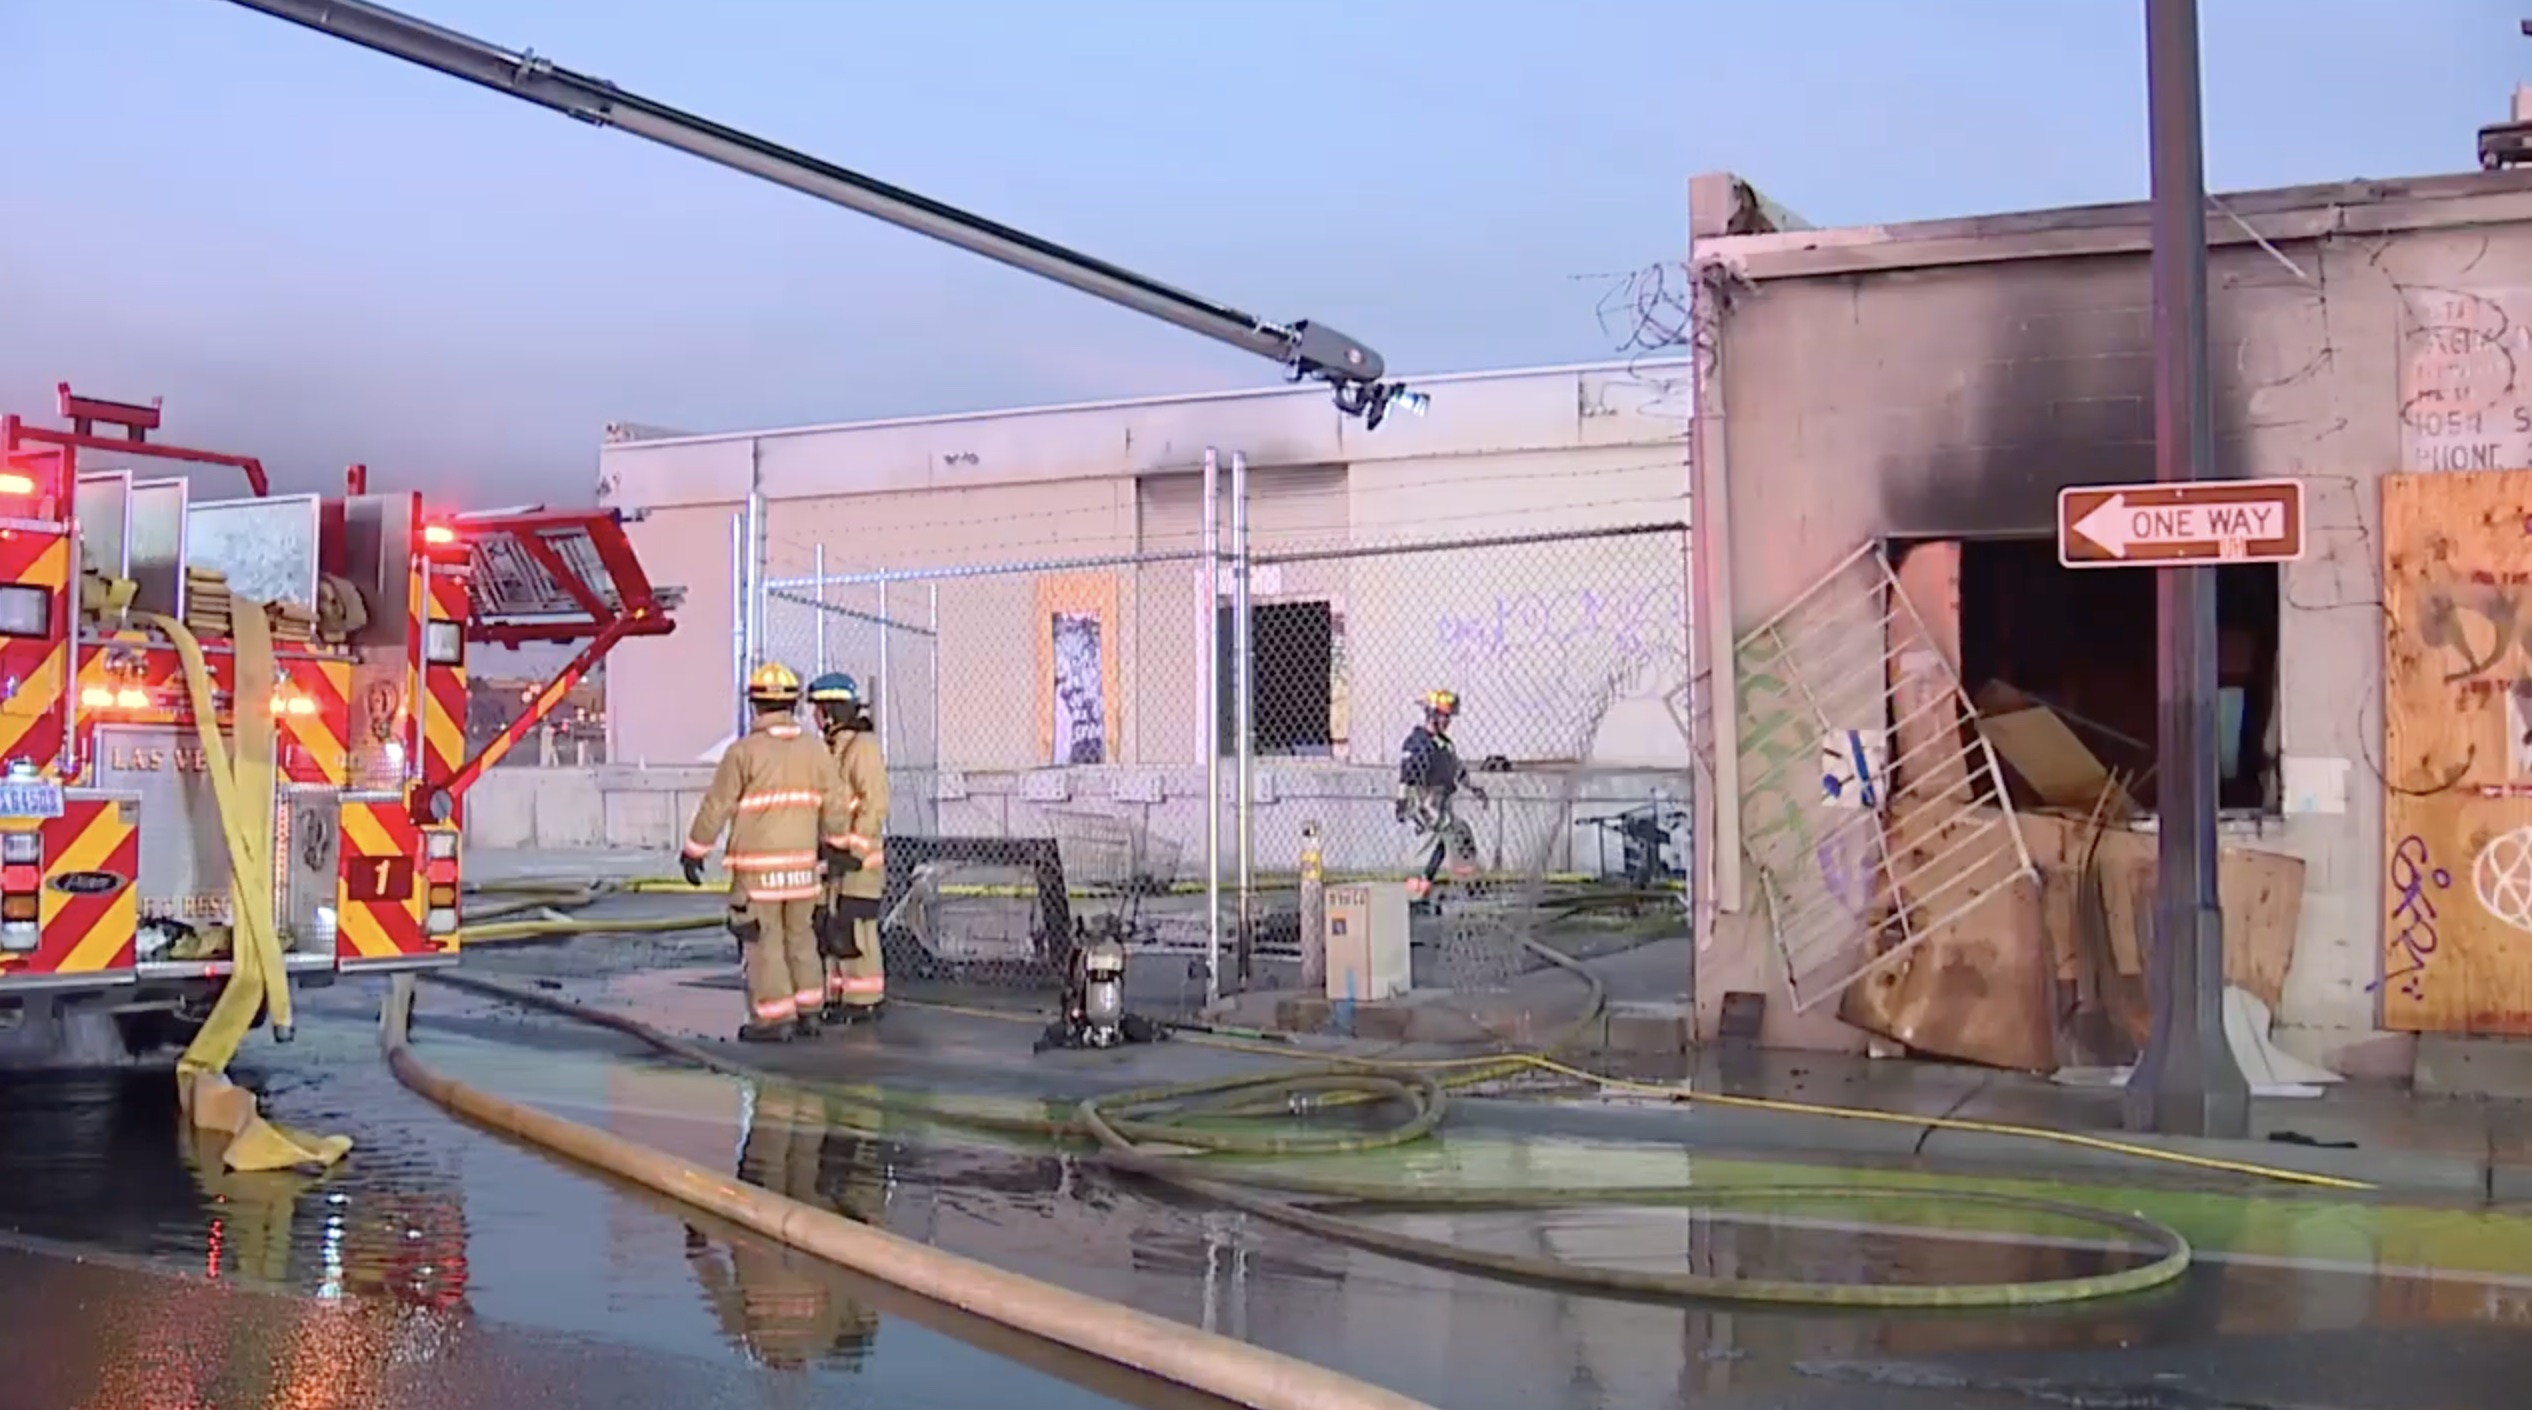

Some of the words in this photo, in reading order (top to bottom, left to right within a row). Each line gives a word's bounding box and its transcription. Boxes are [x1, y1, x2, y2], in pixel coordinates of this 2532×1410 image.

[2132, 509, 2194, 538] ONE
[2207, 507, 2272, 536] WAY
[111, 747, 164, 772] LAS
[374, 859, 391, 896] 1
[182, 895, 232, 919] RESC
